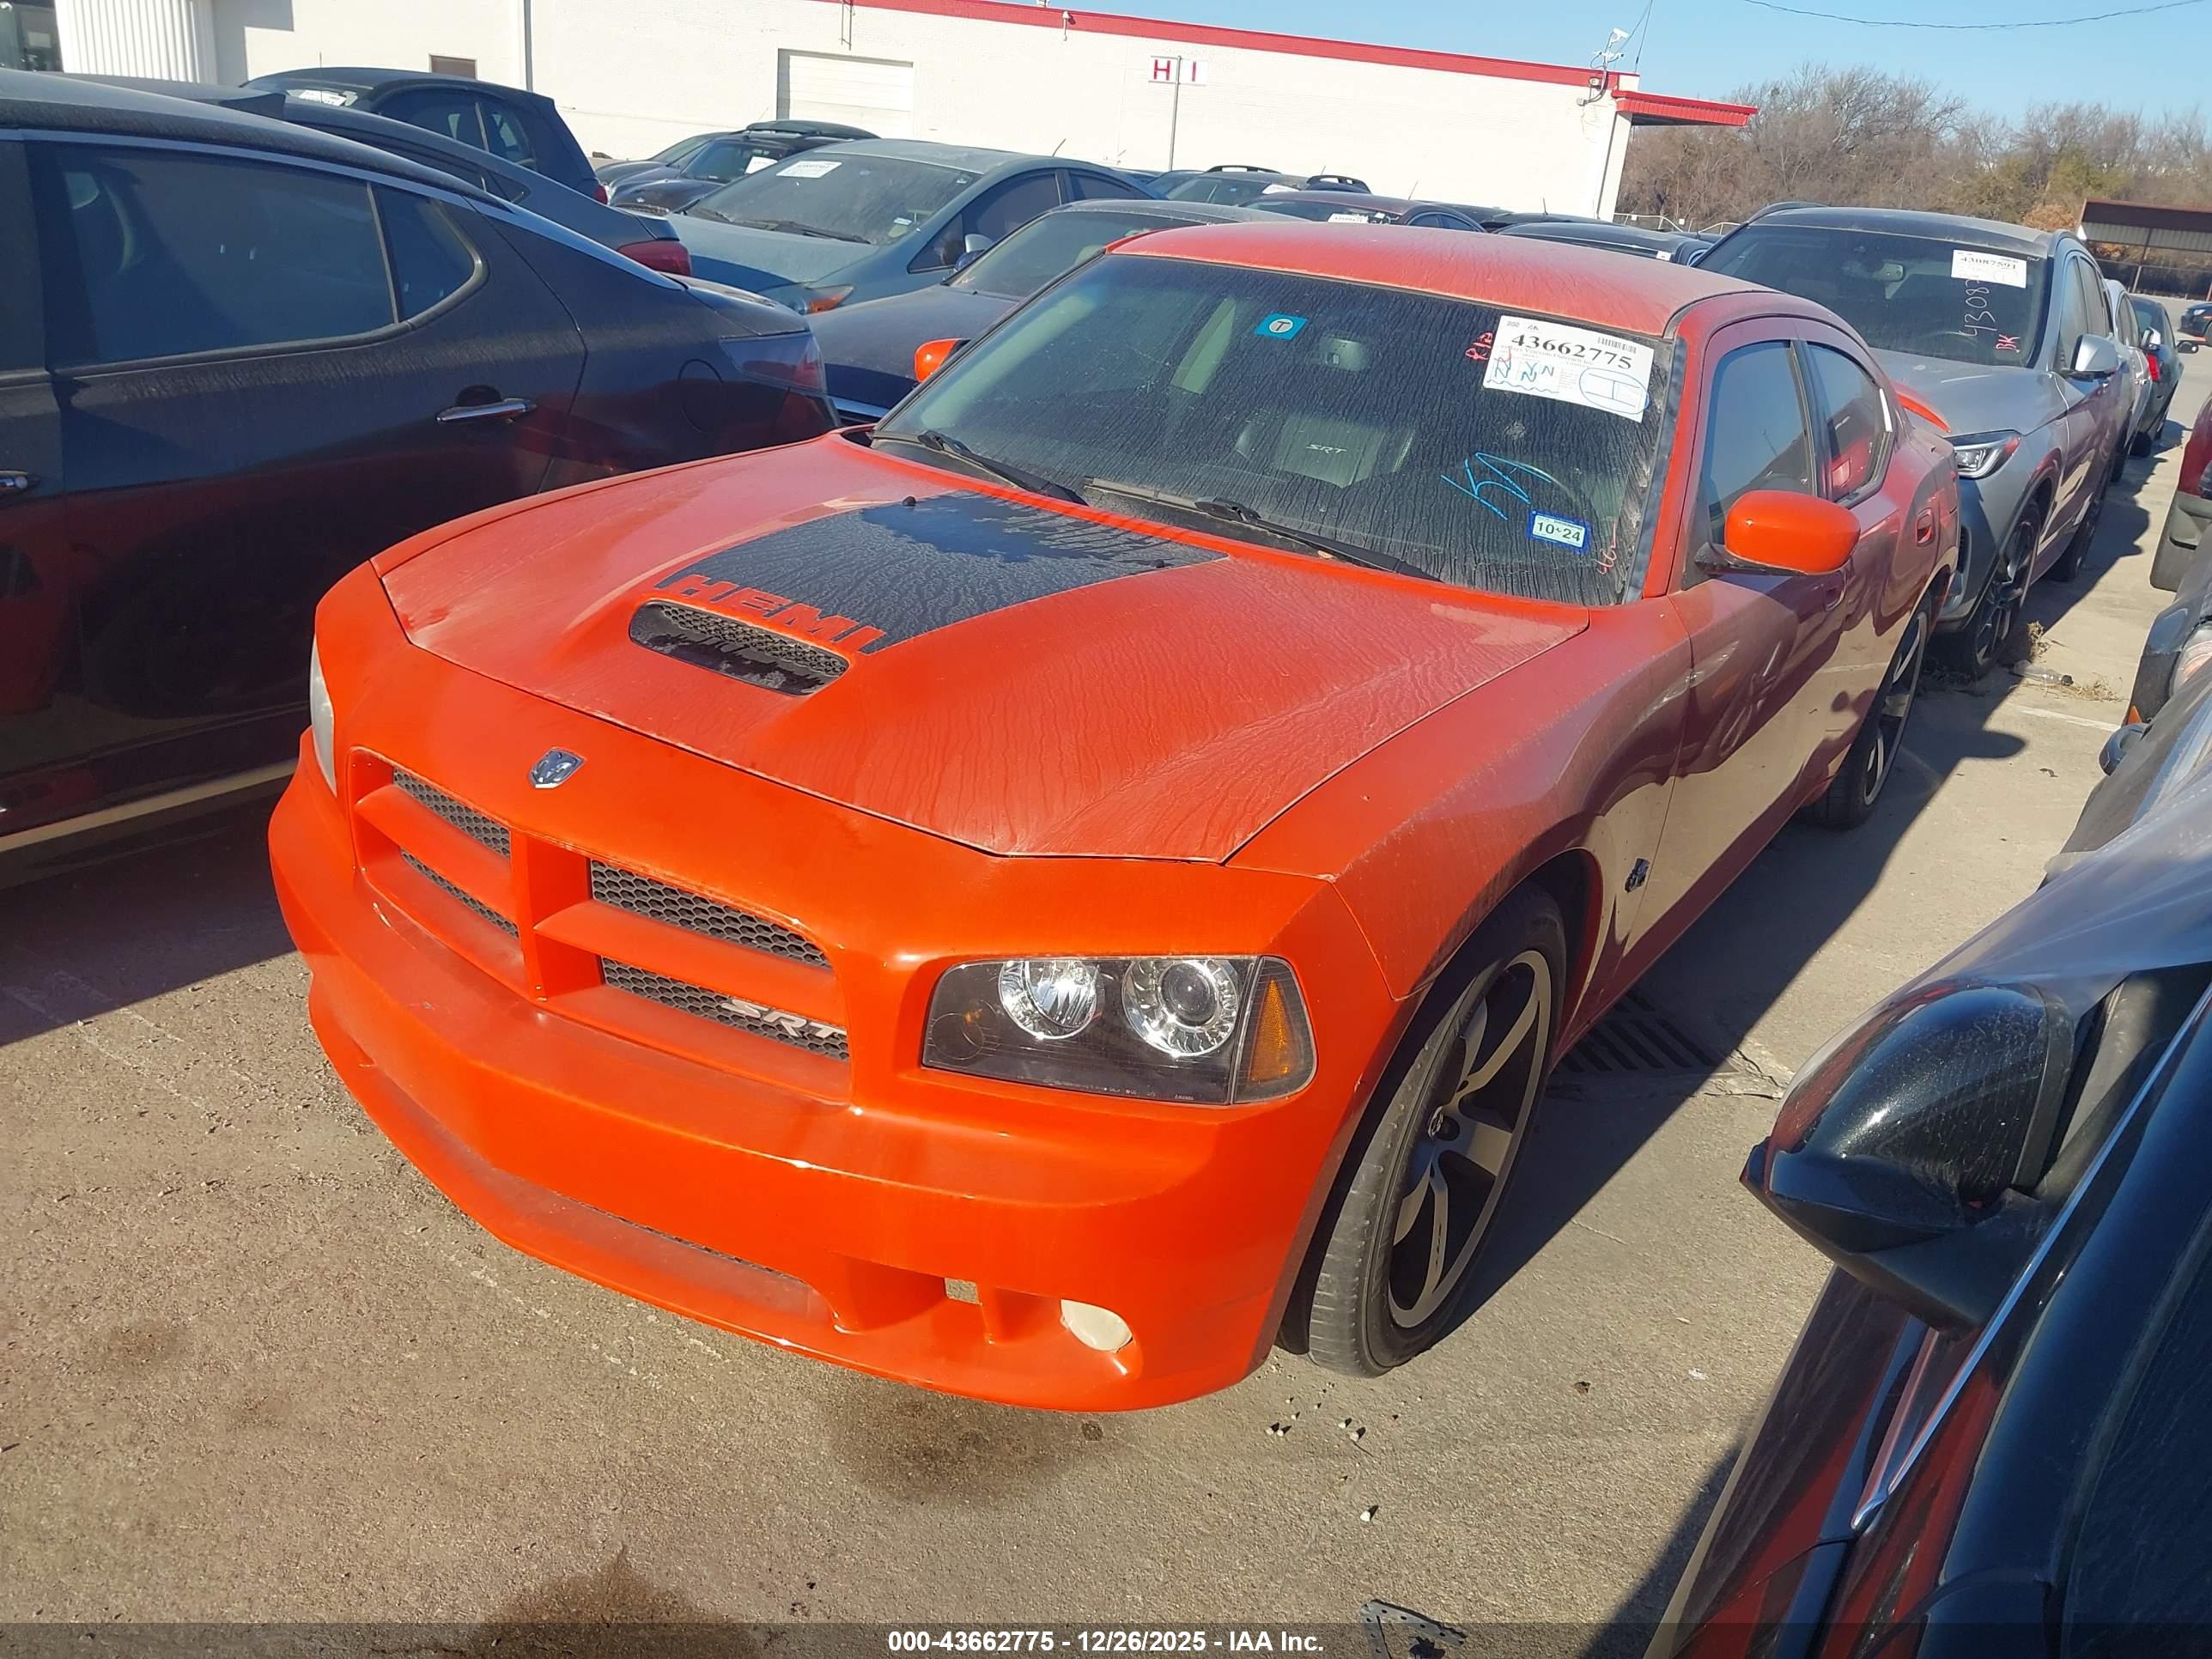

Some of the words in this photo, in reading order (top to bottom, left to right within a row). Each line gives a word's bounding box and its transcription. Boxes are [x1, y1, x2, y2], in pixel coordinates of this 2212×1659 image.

[1153, 59, 1171, 81] H
[1191, 61, 1197, 82] I
[1276, 319, 1290, 332] T
[1511, 333, 1632, 370] 43662775
[1305, 443, 1347, 454] SRT
[662, 574, 887, 652] HEMI
[721, 999, 848, 1037] SRT
